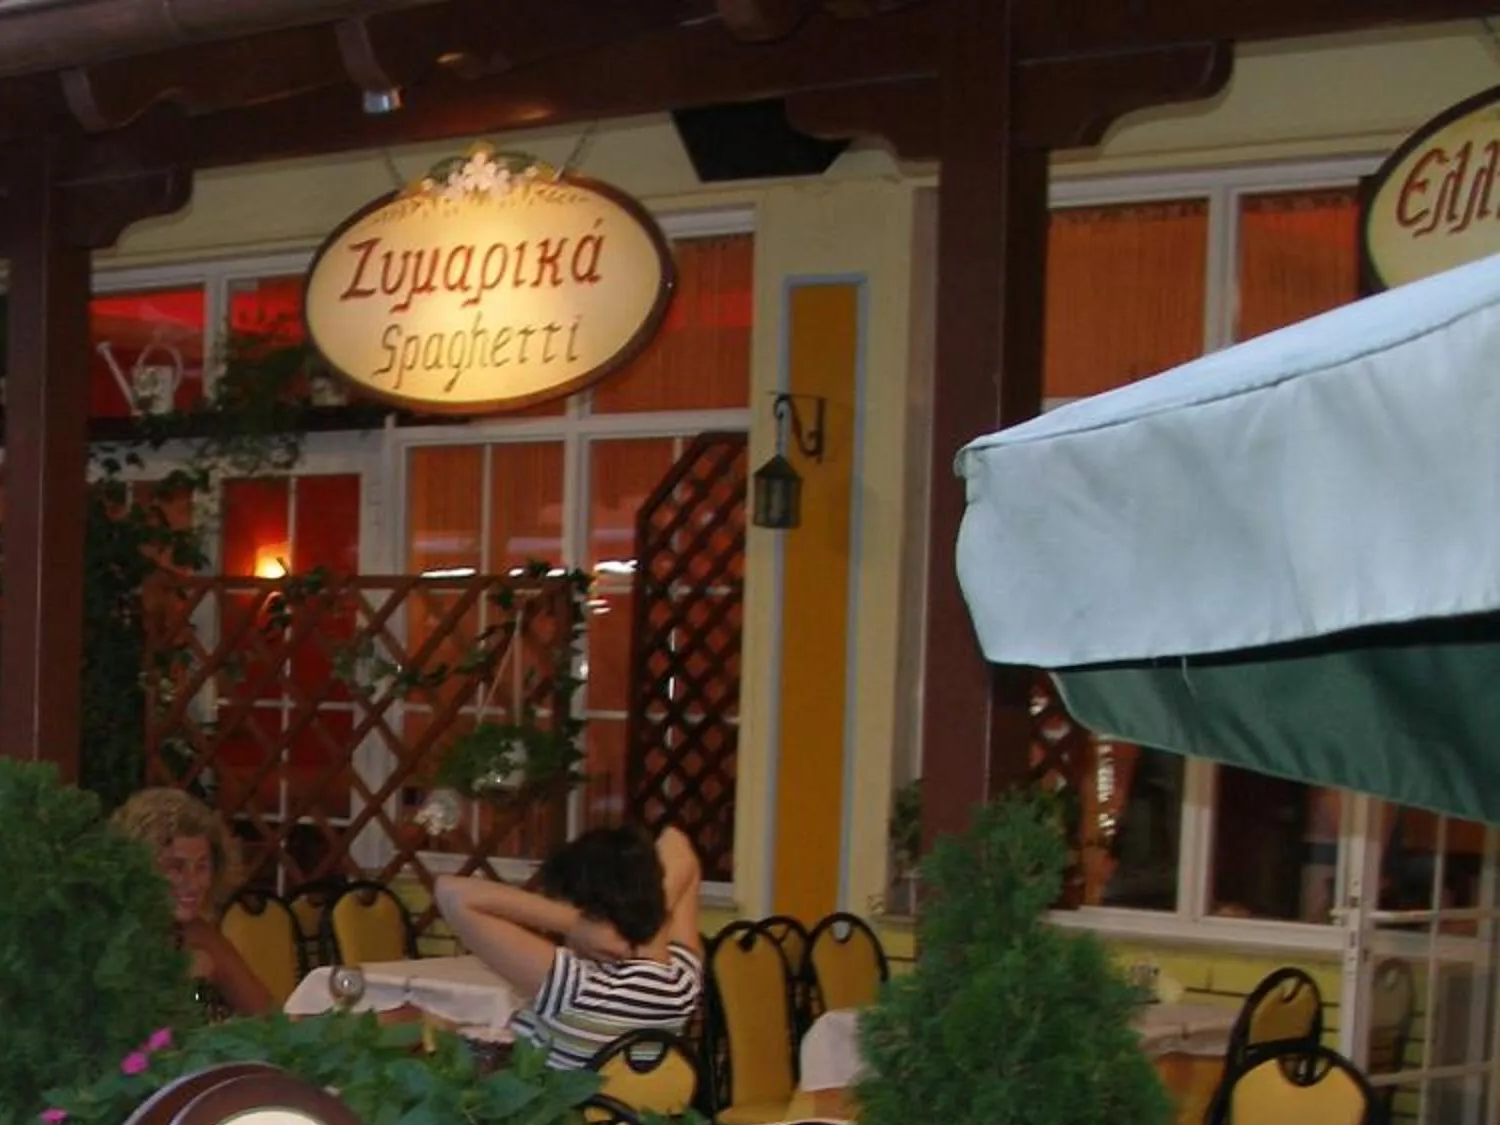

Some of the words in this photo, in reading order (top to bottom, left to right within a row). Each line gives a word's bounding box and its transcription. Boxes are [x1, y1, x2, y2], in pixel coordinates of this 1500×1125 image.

[1395, 138, 1500, 239] Ελλ
[339, 217, 607, 314] Ζυμαρικά
[372, 310, 583, 393] Spaghetti
